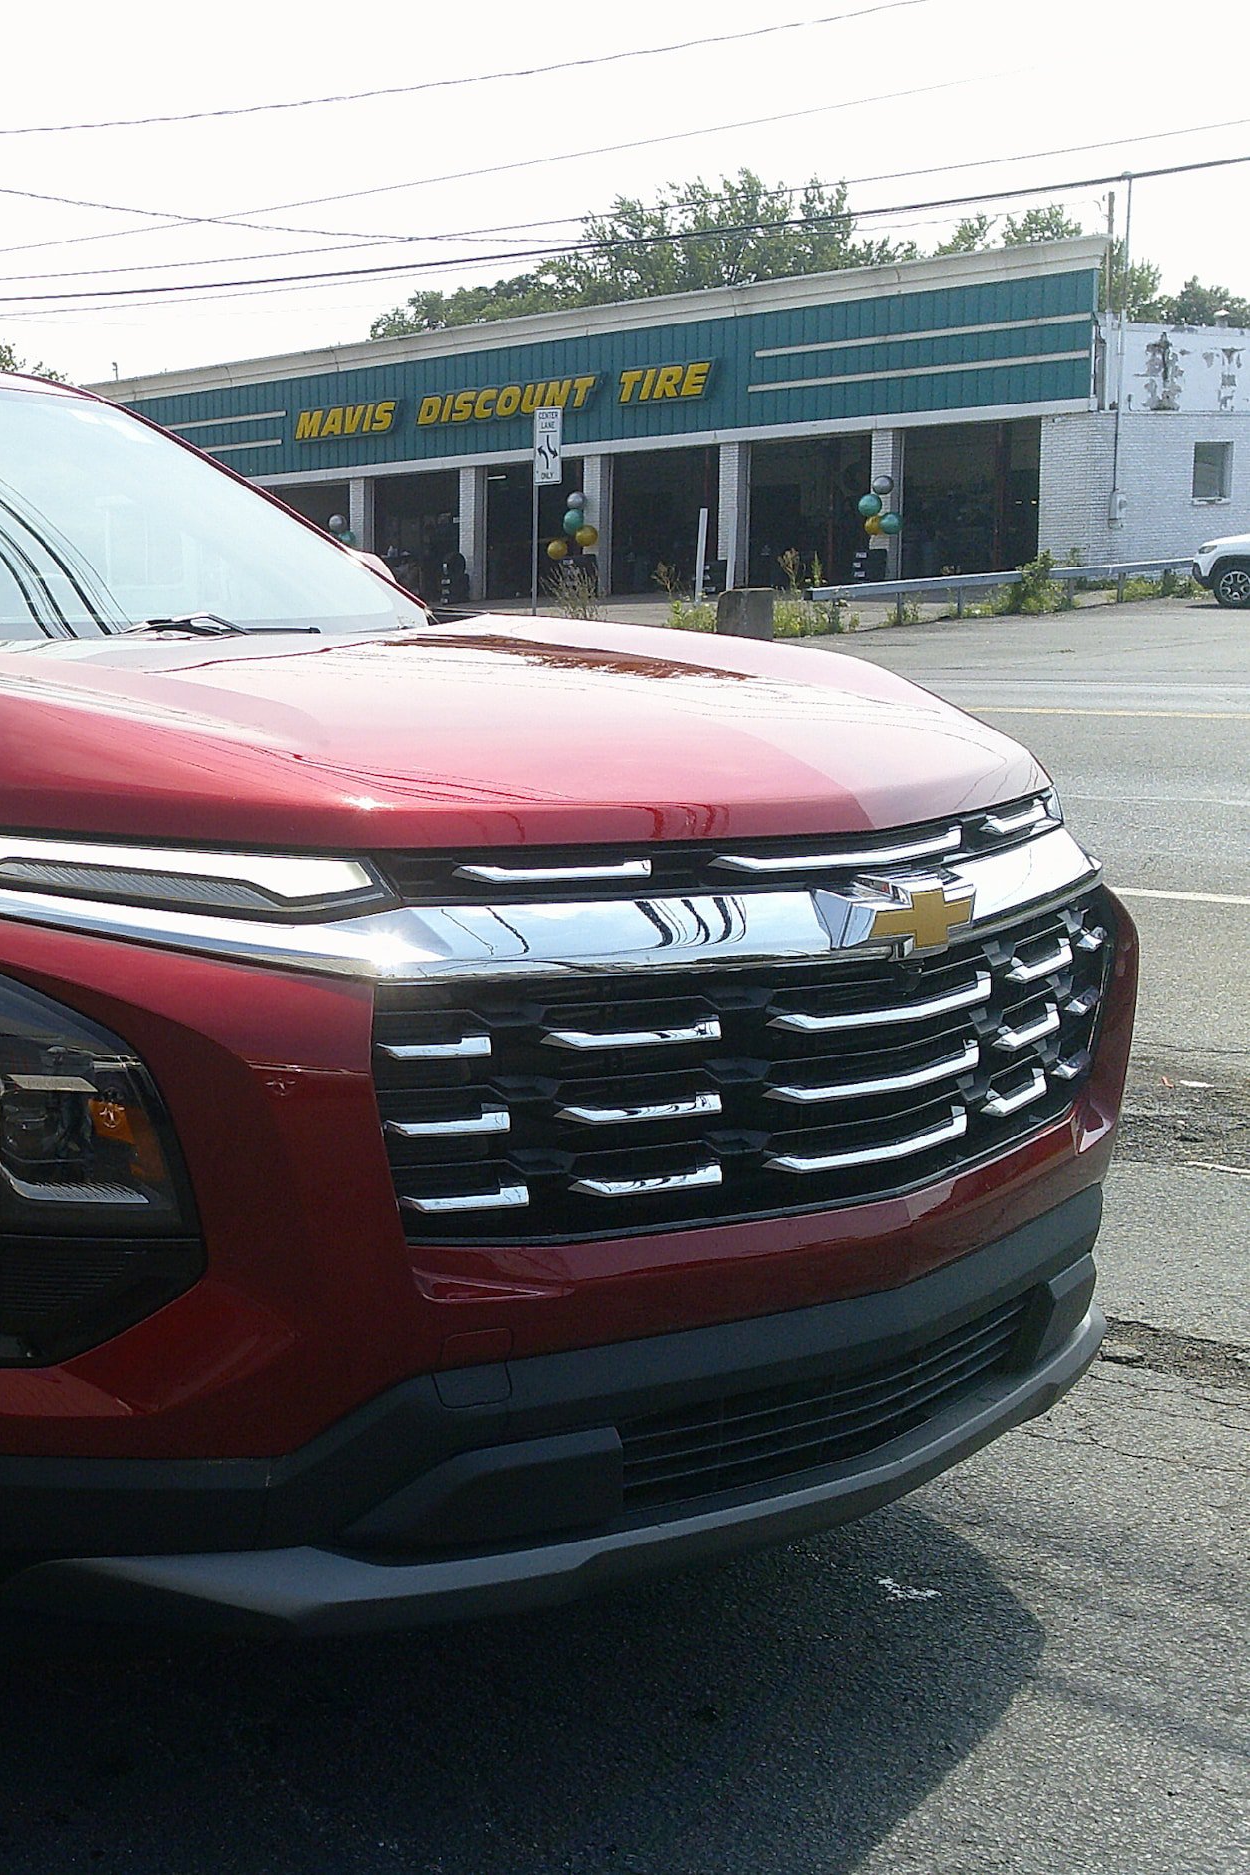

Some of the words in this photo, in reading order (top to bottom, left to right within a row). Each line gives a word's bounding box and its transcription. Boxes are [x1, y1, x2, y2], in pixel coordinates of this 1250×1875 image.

[295, 401, 396, 440] MAVIS
[416, 375, 596, 426] DISCOUNT
[618, 361, 713, 404] TIRE
[538, 411, 558, 419] CENTER
[541, 421, 555, 429] LANE
